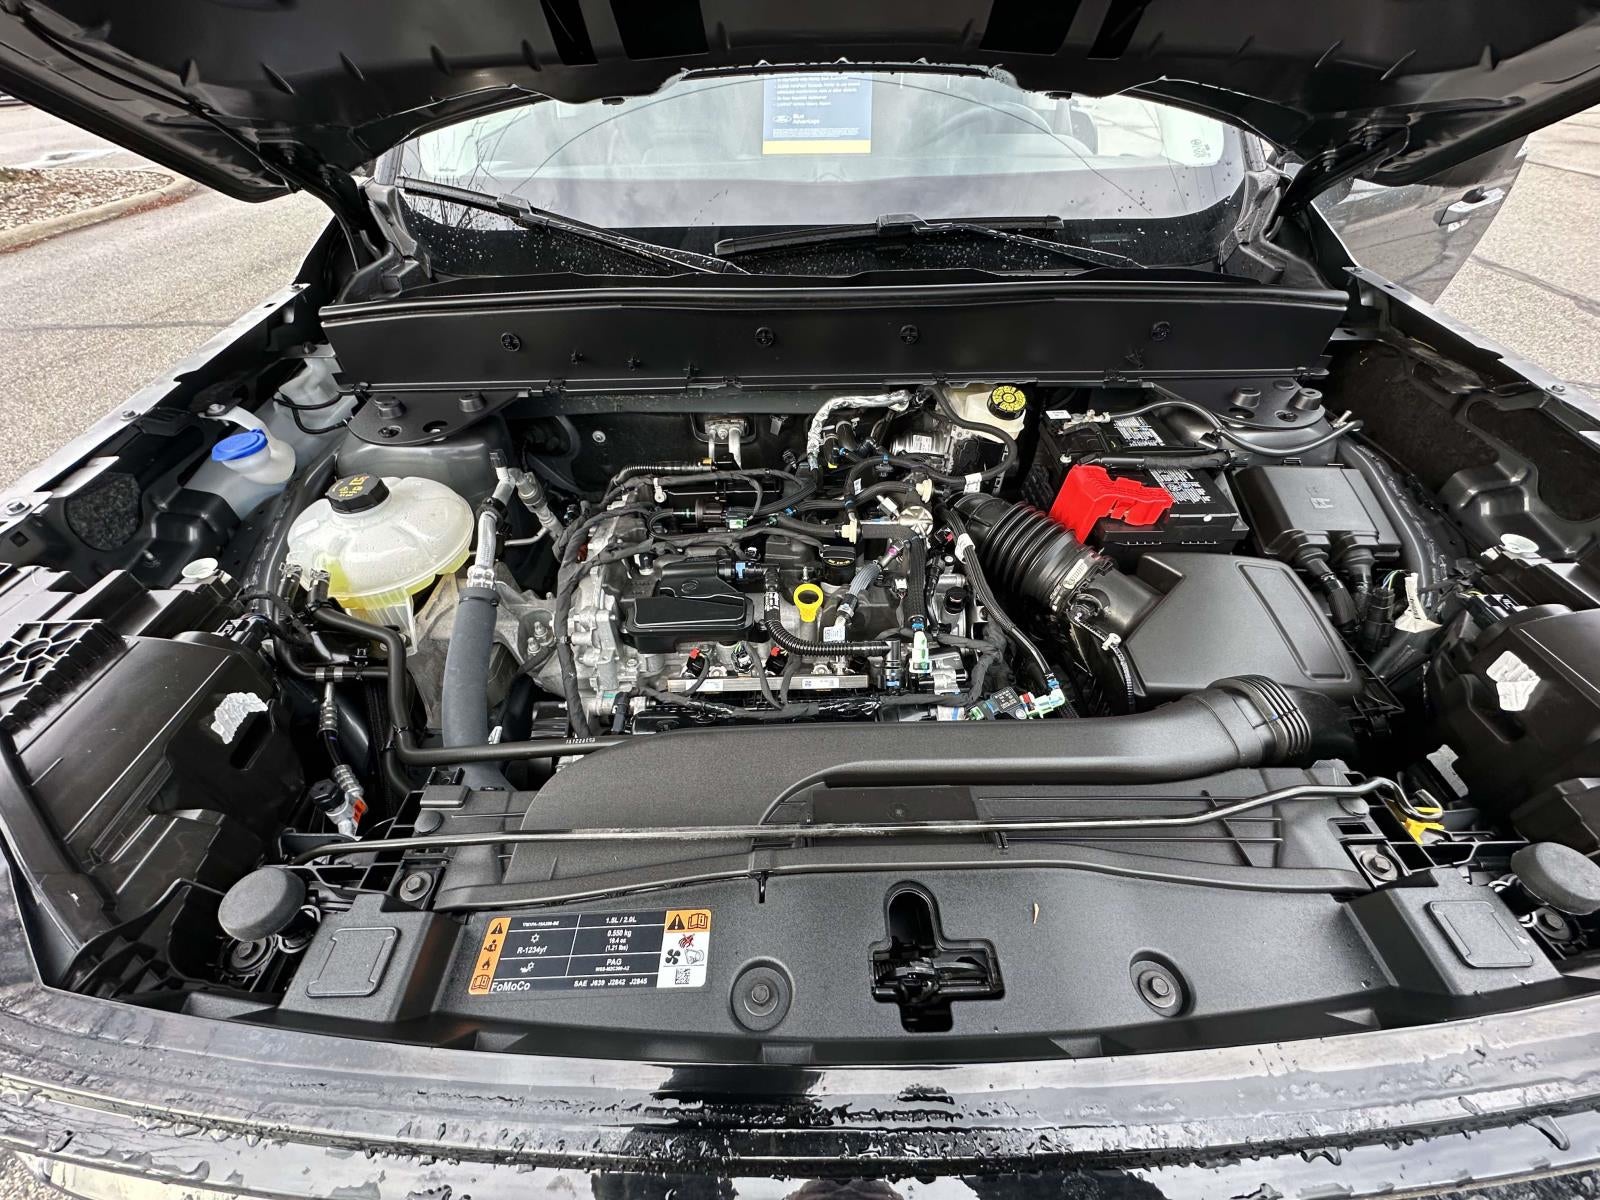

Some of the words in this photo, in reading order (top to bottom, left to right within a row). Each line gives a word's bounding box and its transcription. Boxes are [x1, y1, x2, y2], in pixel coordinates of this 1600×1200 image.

[624, 929, 632, 938] kg
[516, 945, 548, 955] R-1234yf
[606, 958, 622, 966] PAG
[490, 981, 531, 992] FoMoCo
